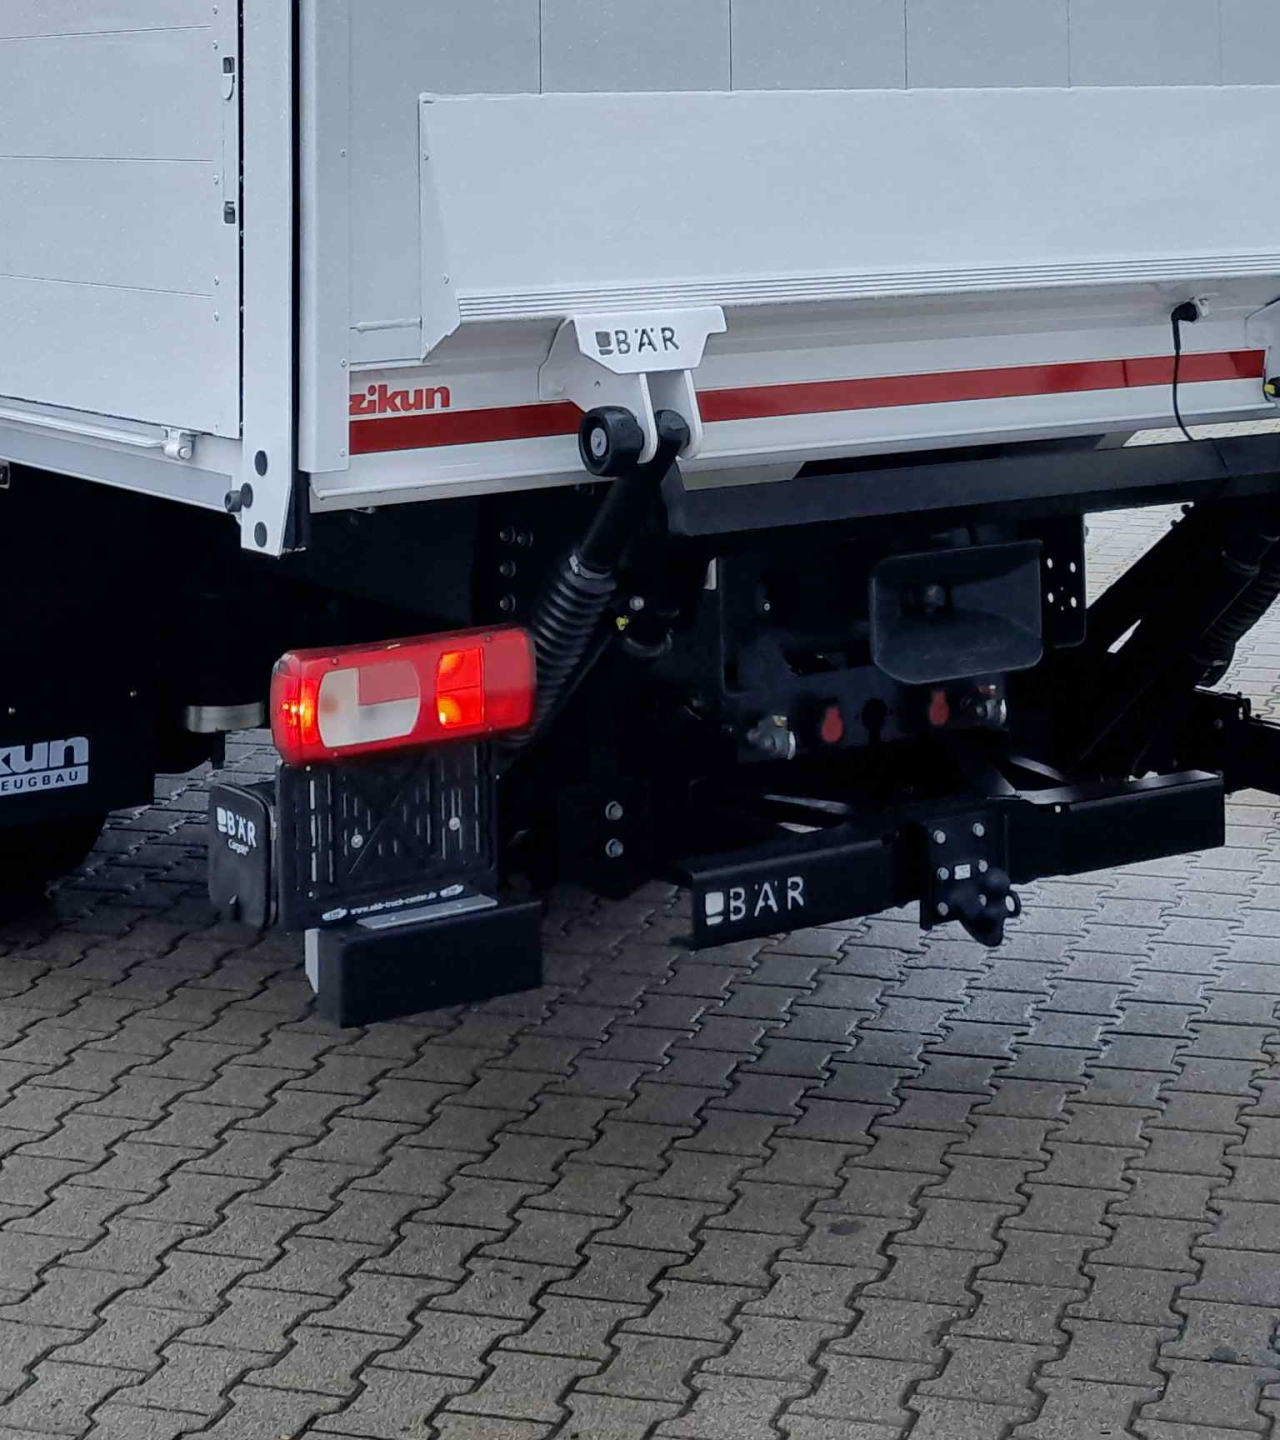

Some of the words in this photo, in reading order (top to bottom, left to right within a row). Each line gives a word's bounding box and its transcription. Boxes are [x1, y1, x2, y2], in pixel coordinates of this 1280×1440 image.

[614, 326, 680, 355] BÄR
[349, 384, 451, 416] zikun
[226, 810, 257, 848] BÄR
[729, 875, 804, 922] BÄR
